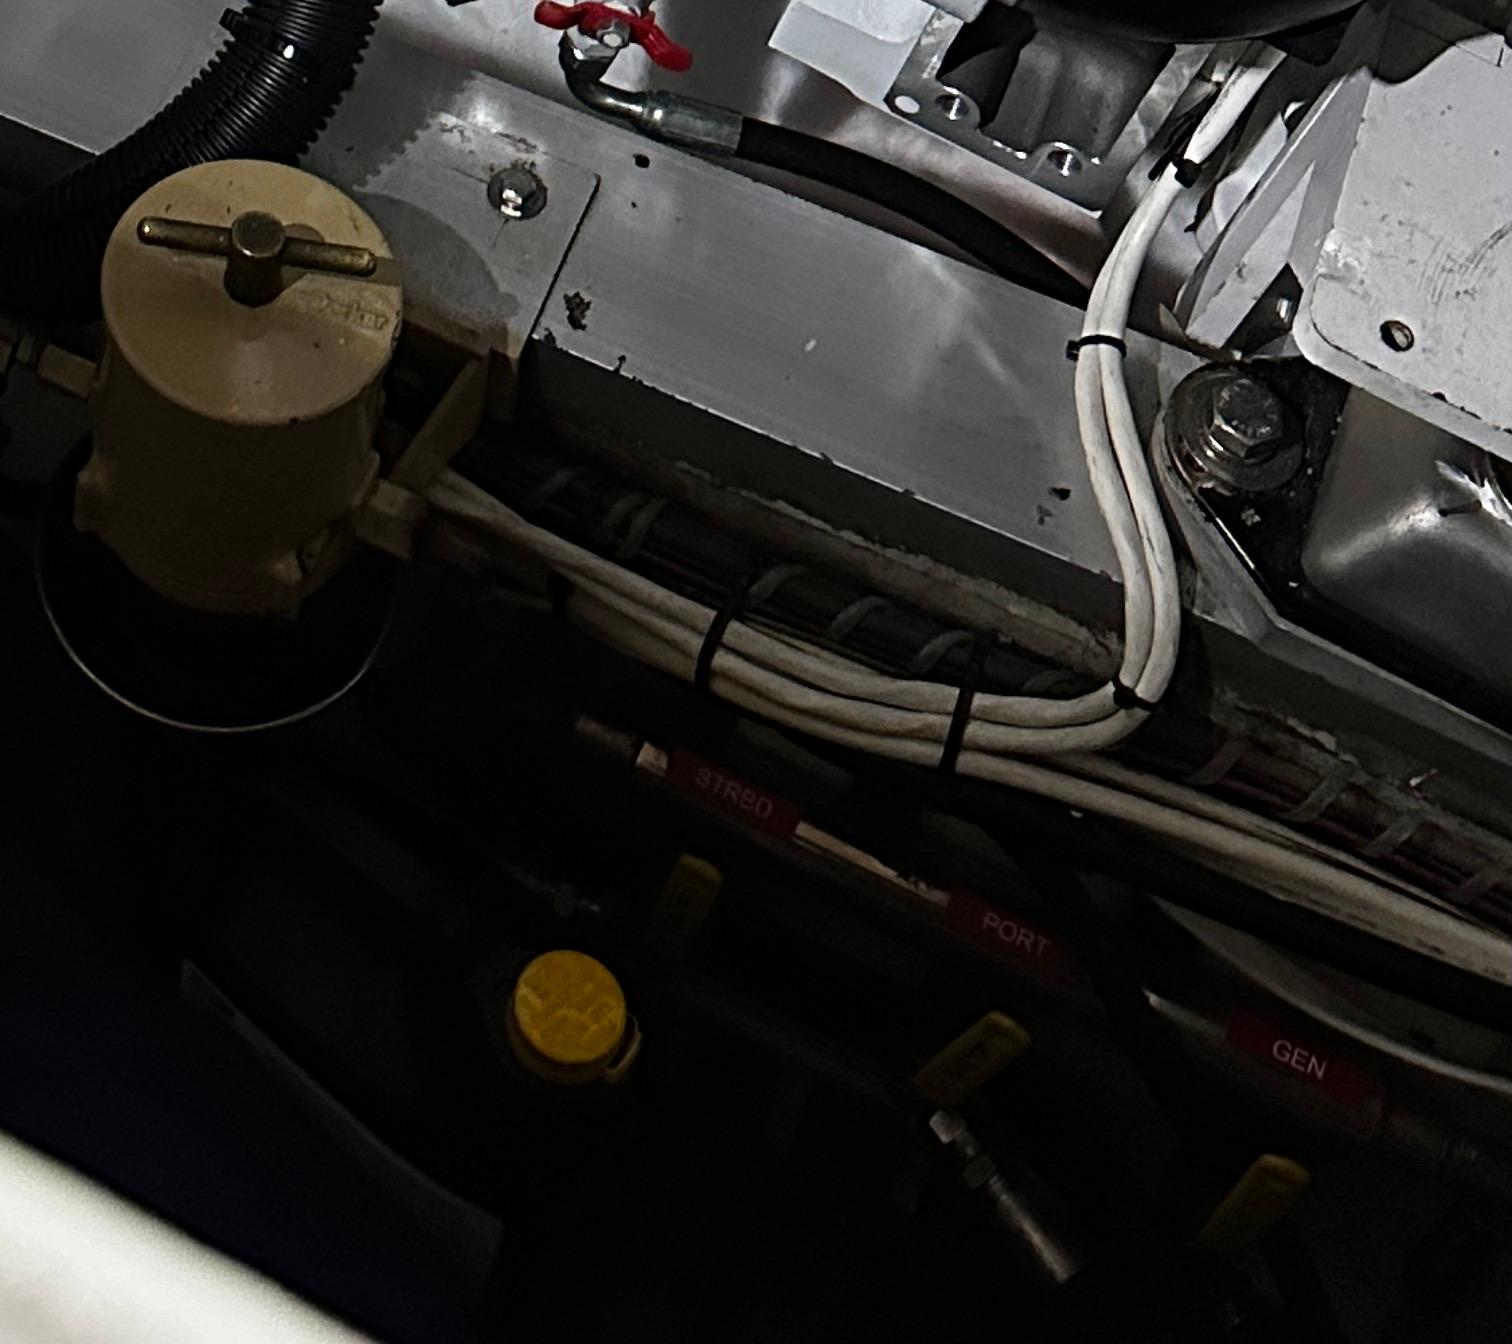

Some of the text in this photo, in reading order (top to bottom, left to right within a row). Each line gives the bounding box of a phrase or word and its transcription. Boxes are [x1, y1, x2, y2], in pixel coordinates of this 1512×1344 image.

[695, 767, 774, 819] STRBD
[982, 911, 1053, 957] PORT
[1272, 1039, 1327, 1080] GEN
